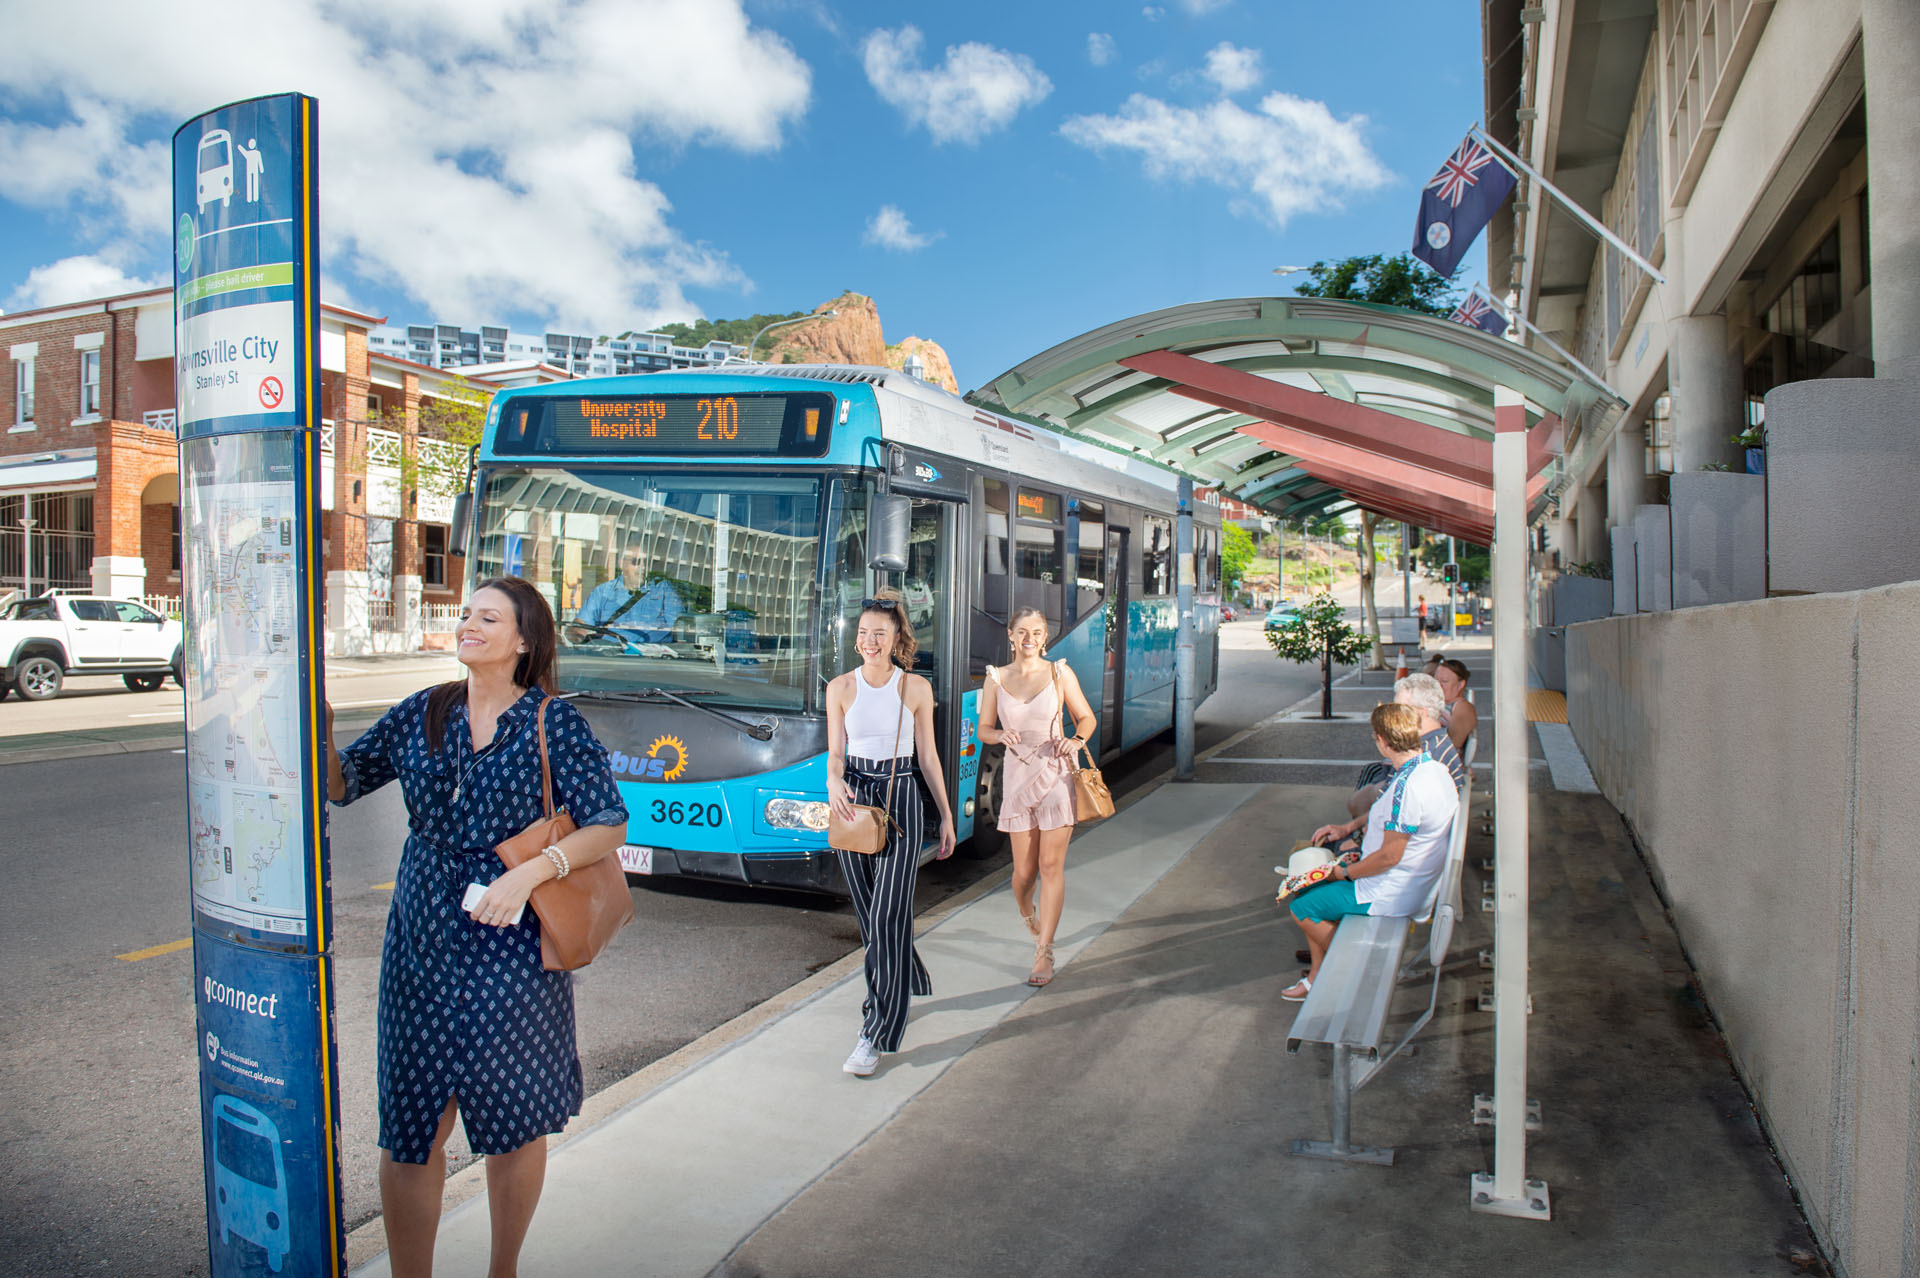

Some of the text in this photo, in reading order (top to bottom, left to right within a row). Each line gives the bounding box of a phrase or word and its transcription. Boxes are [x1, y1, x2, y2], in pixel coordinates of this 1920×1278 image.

[206, 279, 225, 292] please
[226, 274, 240, 286] hail
[241, 272, 265, 283] driver
[242, 336, 279, 364] City
[196, 370, 239, 390] Stanley St
[581, 399, 666, 419] University
[697, 397, 738, 439] 210
[591, 418, 656, 439] Hospital
[960, 759, 977, 781] 3620
[650, 799, 723, 828] 3620
[204, 975, 278, 1019] qconnect
[229, 1050, 258, 1068] information
[221, 1060, 285, 1086] www.qconnect.qld.gov.au
